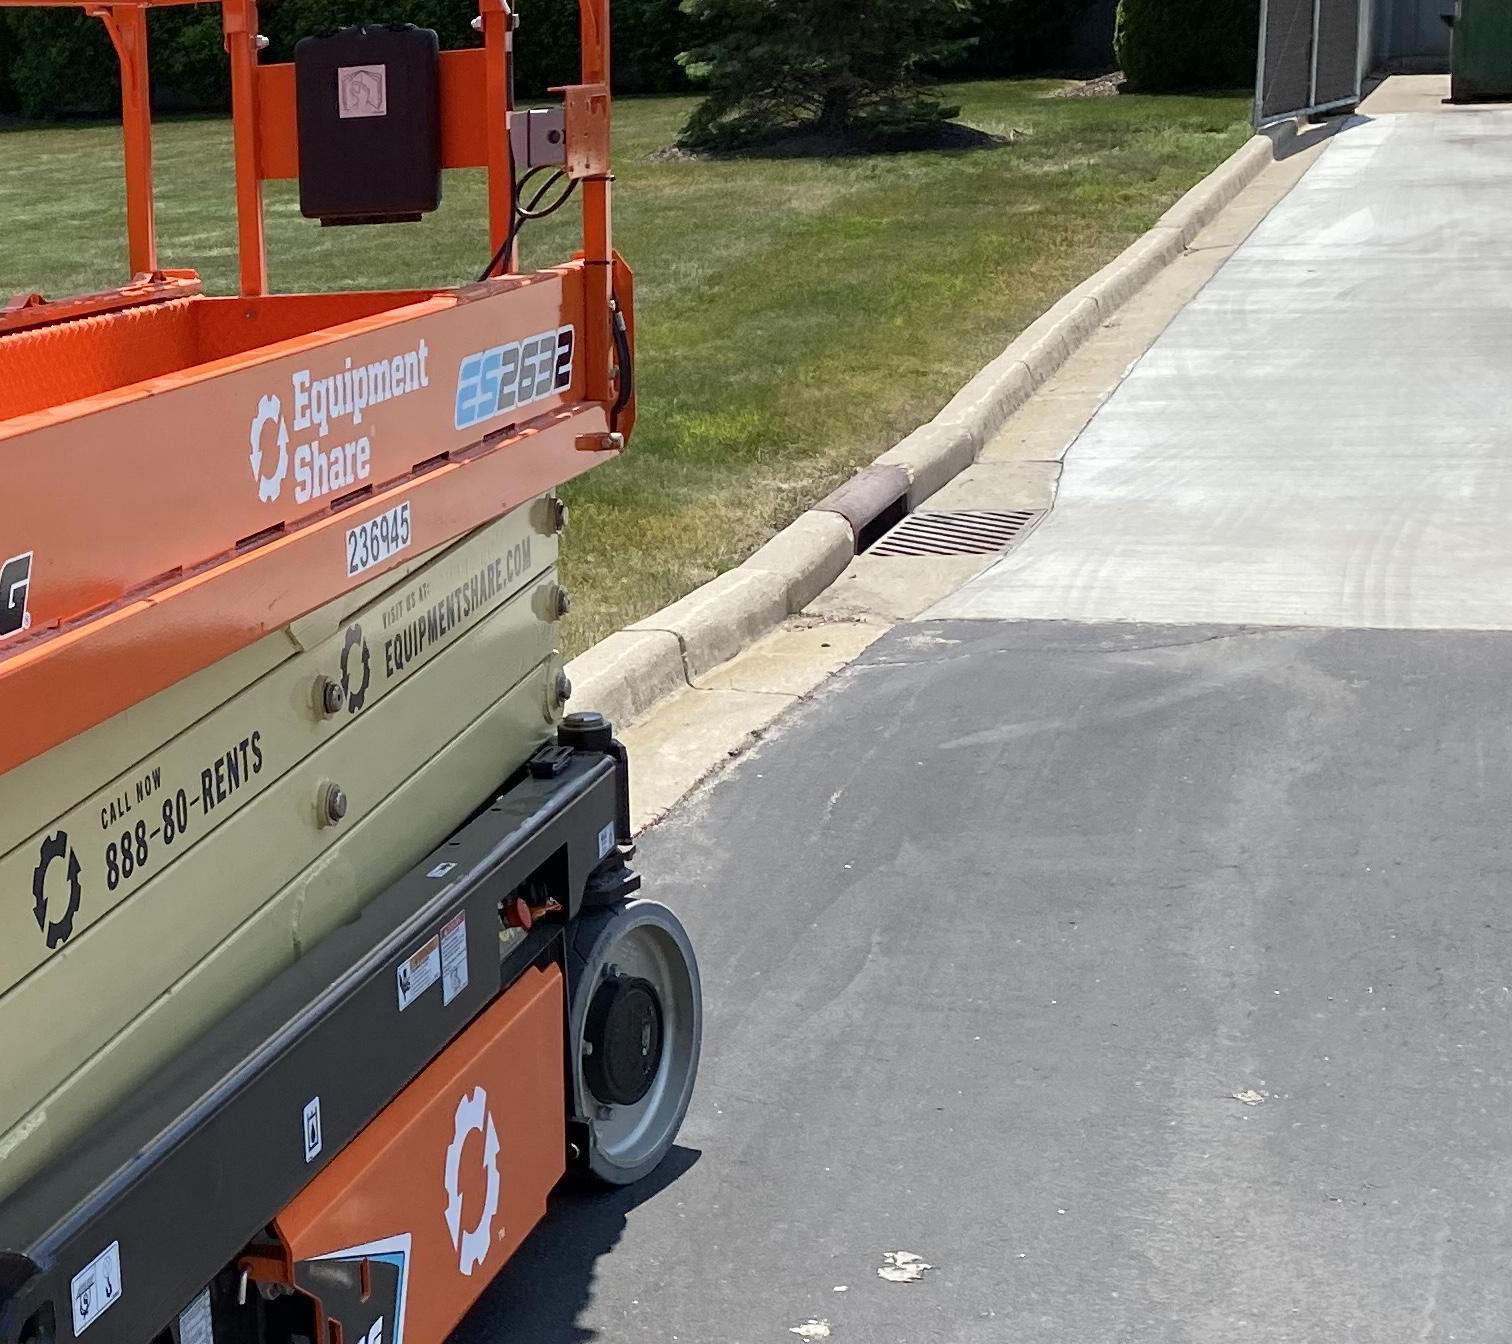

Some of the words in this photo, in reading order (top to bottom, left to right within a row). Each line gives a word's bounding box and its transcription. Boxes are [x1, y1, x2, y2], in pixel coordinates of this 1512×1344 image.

[292, 338, 429, 437] Equipment
[454, 324, 575, 430] ES2632
[294, 436, 371, 504] Share
[347, 504, 410, 574] 236945
[382, 605, 403, 630] VISIT
[384, 535, 532, 679] EQUIPMENTSHARE.COM
[100, 791, 132, 830] CALL
[135, 766, 161, 803] NOW
[105, 730, 263, 891] 888-80-RENTS
